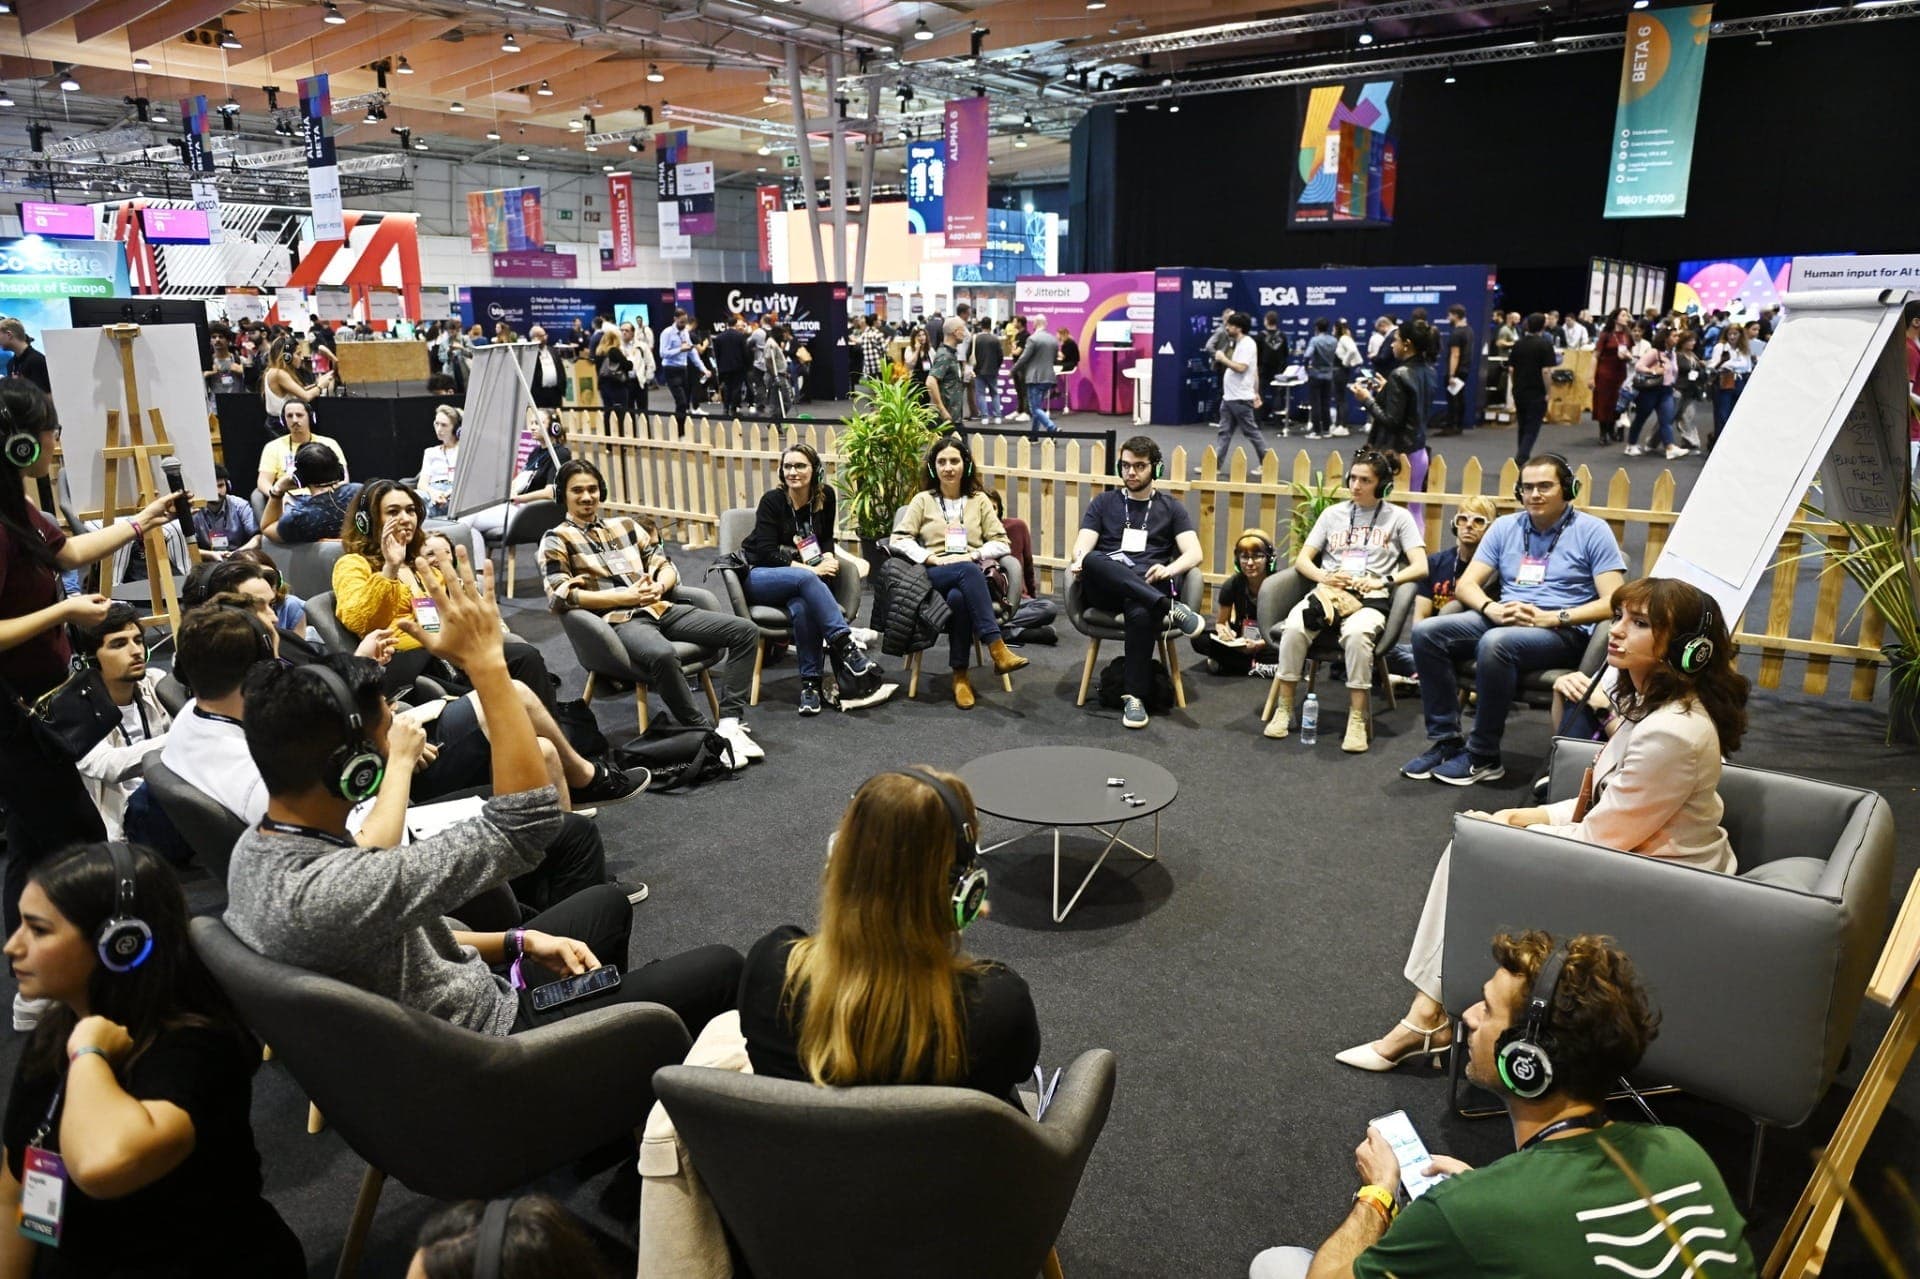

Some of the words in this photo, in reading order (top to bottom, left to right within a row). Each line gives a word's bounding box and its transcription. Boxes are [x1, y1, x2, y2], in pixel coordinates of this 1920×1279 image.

[1638, 25, 1652, 37] 6
[1632, 40, 1650, 82] BETA
[303, 116, 314, 159] ALPHA
[314, 125, 323, 158] BETA
[950, 120, 958, 161] ALPHA
[1804, 270, 1844, 278] Human
[1847, 268, 1877, 279] input
[1880, 267, 1898, 277] for
[1900, 267, 1912, 276] AI
[43, 282, 57, 293] of
[60, 283, 106, 295] Europe
[1034, 287, 1070, 297] Jitterbit
[1192, 280, 1212, 299] BGA
[1259, 287, 1299, 306] BGA
[728, 290, 798, 315] Gravity
